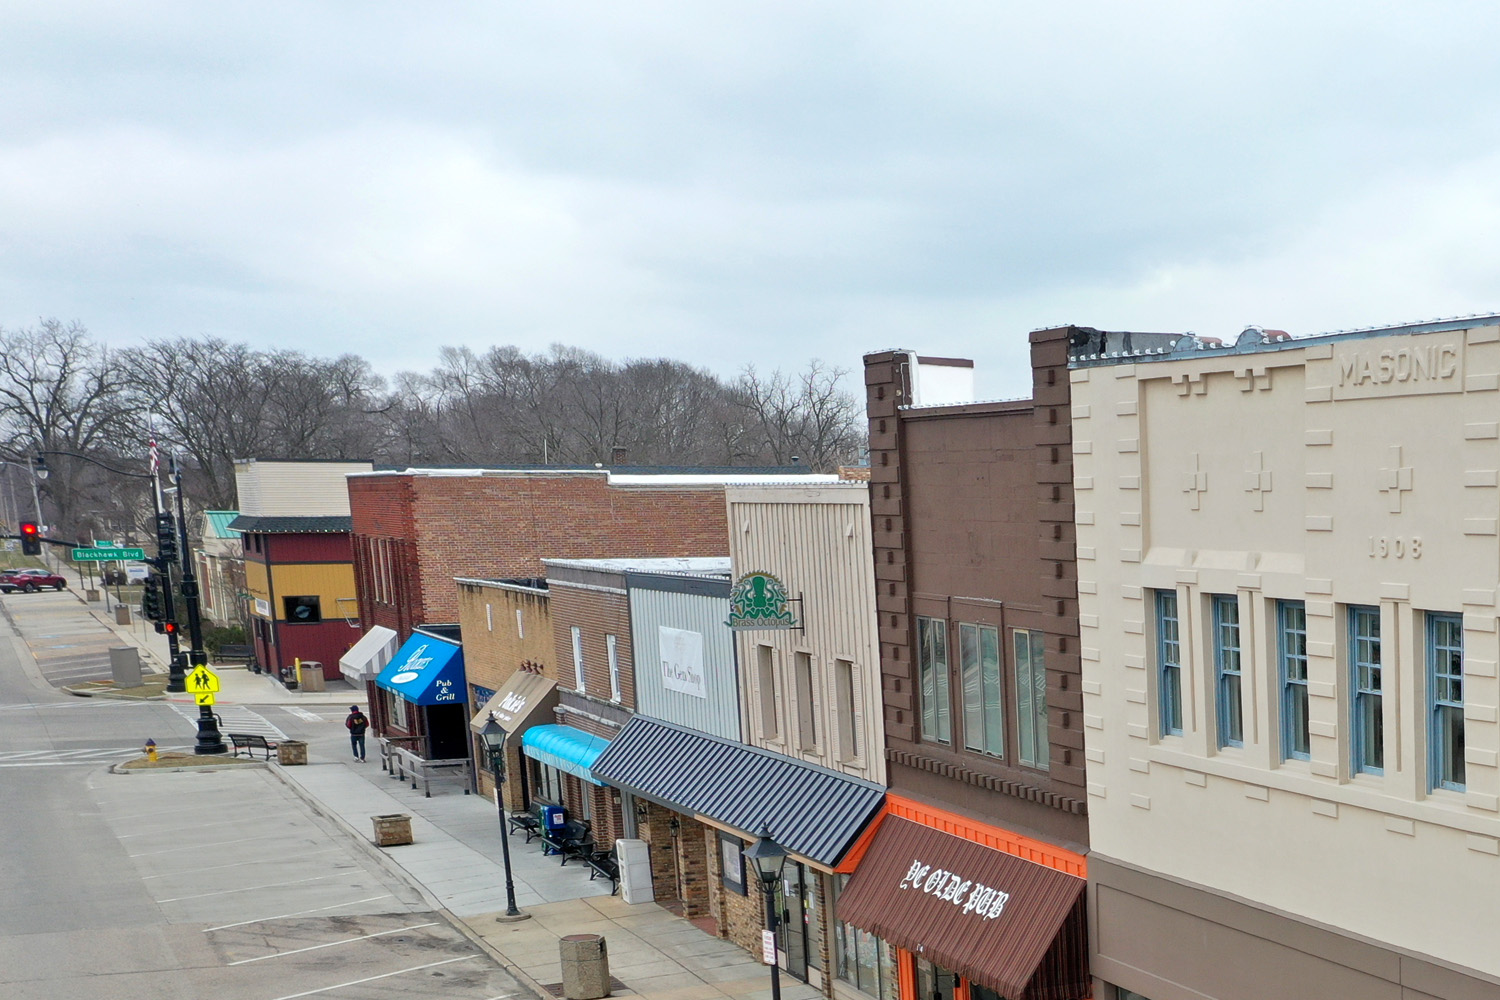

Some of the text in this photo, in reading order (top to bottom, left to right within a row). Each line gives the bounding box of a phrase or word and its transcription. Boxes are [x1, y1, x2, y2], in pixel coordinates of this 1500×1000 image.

[1338, 344, 1457, 388] MASONIC
[733, 618, 789, 629] Brass Octopus
[662, 660, 673, 678] The
[435, 693, 455, 702] Grill
